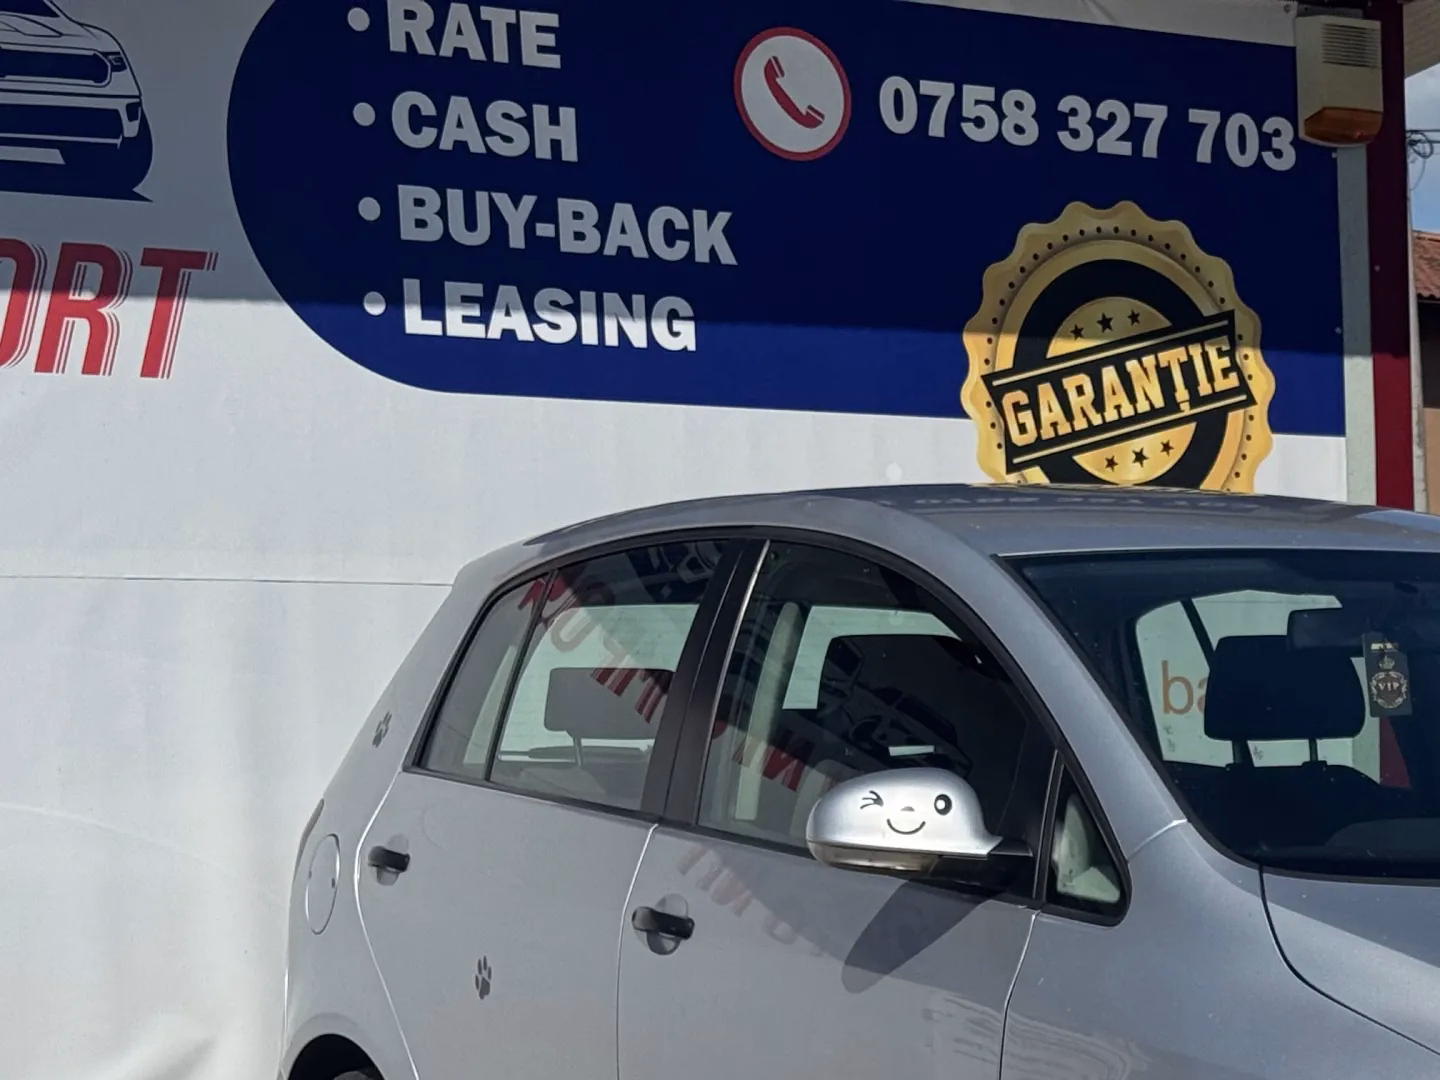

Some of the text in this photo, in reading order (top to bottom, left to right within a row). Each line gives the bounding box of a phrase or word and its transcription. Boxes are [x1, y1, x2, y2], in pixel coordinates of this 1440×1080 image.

[387, 0, 561, 69] RATE
[391, 90, 579, 163] CASH
[879, 75, 1297, 172] 0758 327 703
[397, 184, 738, 266] BUY-BACK
[402, 278, 697, 352] LEASING
[1378, 681, 1400, 691] VIP
